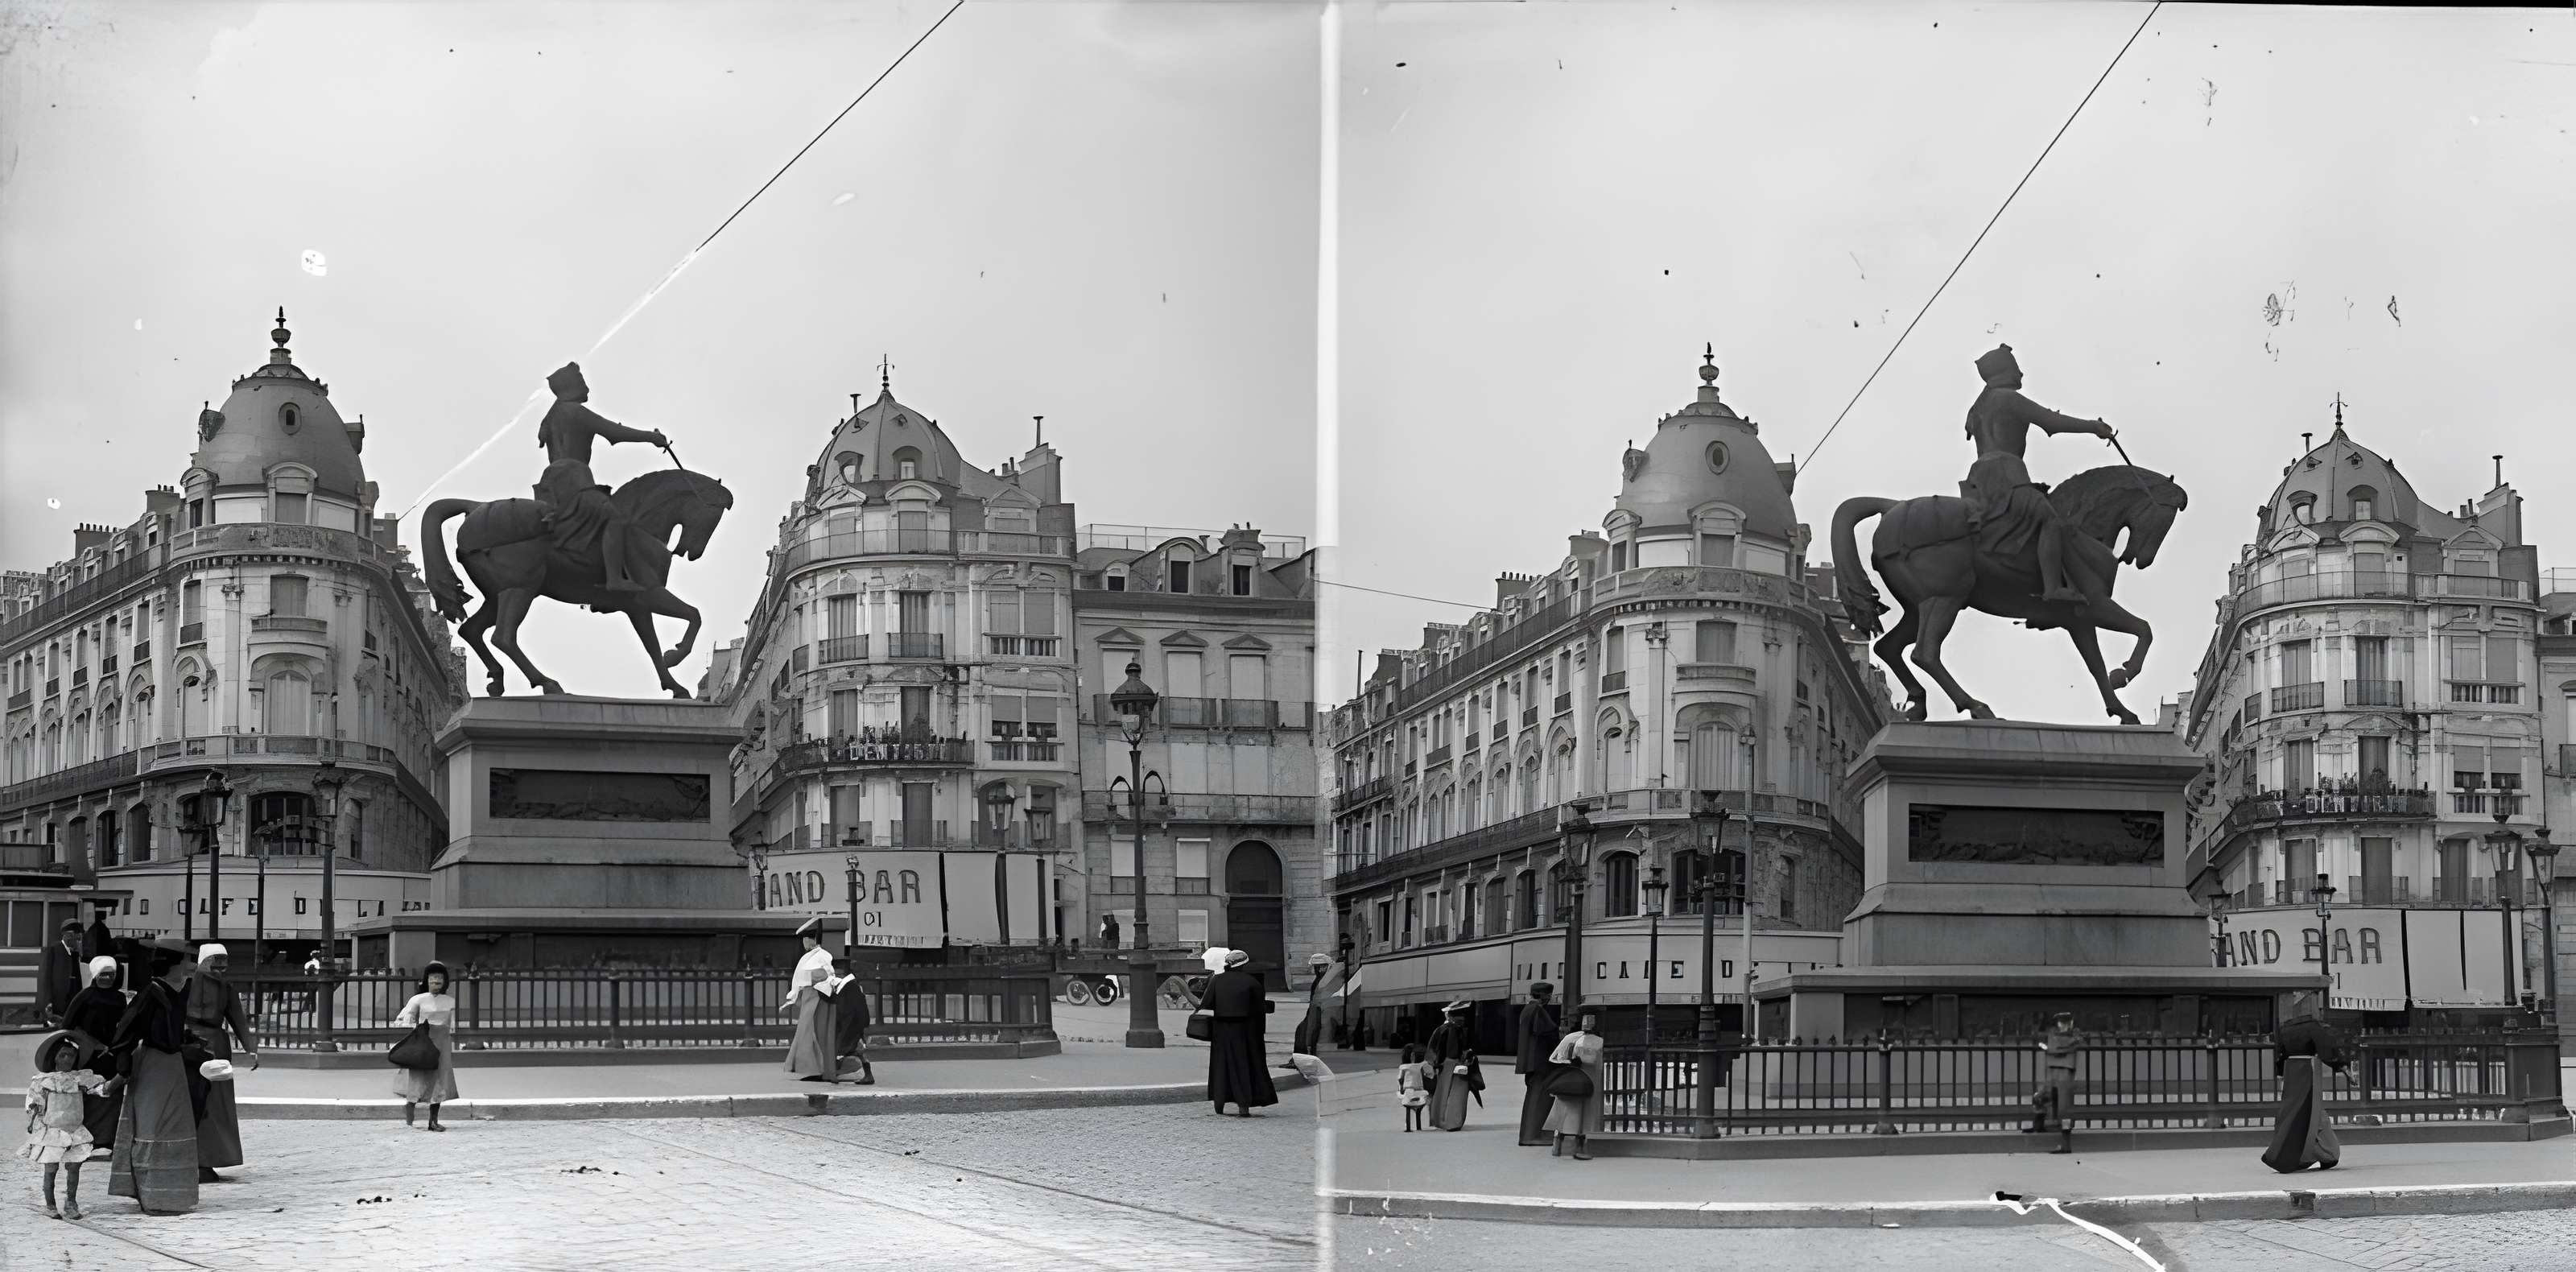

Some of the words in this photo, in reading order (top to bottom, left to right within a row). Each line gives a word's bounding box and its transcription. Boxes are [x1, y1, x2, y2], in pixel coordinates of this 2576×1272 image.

[845, 869, 922, 903] BAR
[2211, 928, 2281, 966] AND
[2301, 927, 2383, 964] BAR
